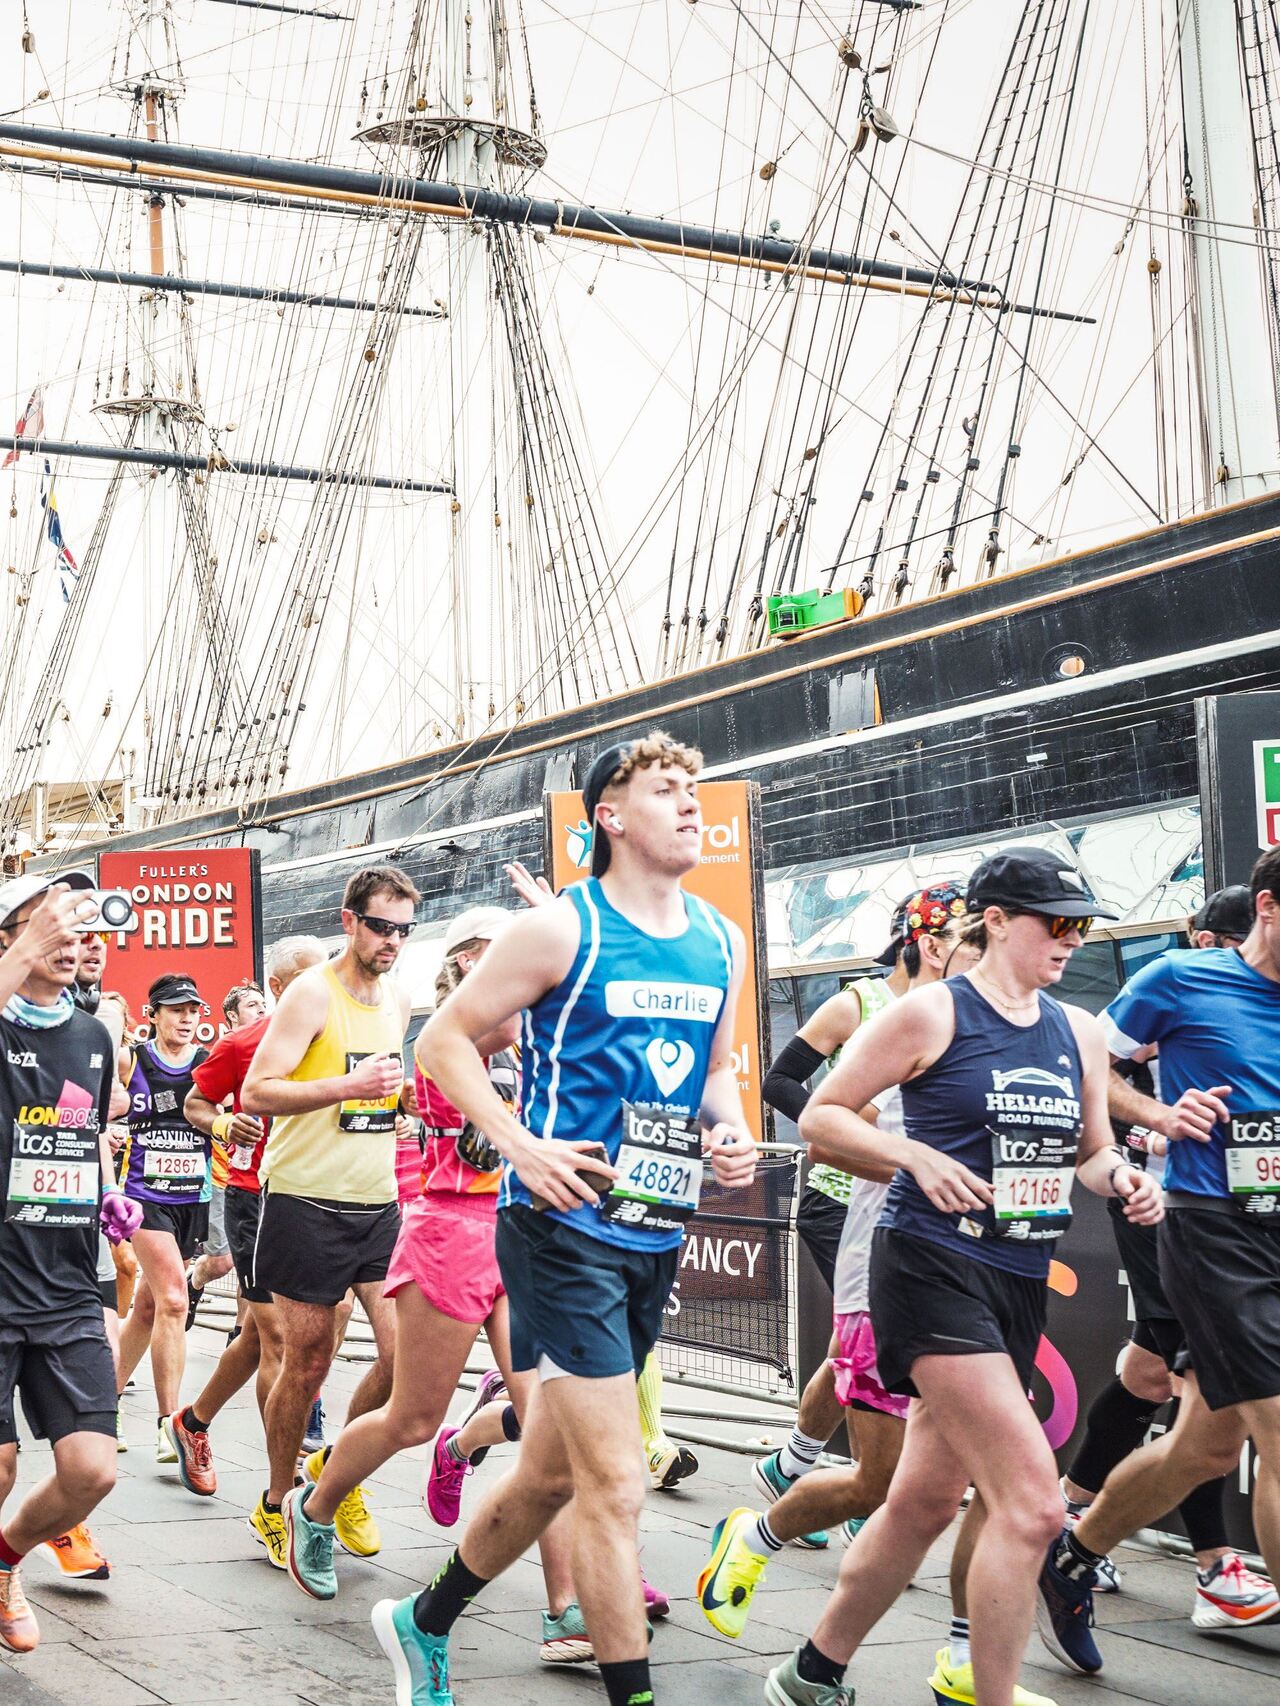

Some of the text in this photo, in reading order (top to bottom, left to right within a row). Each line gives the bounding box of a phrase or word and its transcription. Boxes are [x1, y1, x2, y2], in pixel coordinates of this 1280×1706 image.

[140, 863, 209, 878] FULLER'S
[117, 882, 233, 904] ONDON
[632, 988, 708, 1013] Charlie
[985, 1093, 1081, 1119] HELLGATE
[998, 1113, 1032, 1124] ROAD
[629, 1111, 666, 1145] tcs
[1232, 1119, 1273, 1142] tcs
[19, 1129, 54, 1155] tcs
[999, 1134, 1039, 1162] tcs
[156, 1158, 198, 1174] 12867
[629, 1160, 691, 1196] 48821
[33, 1169, 81, 1194] 8211
[1009, 1178, 1061, 1205] 12166
